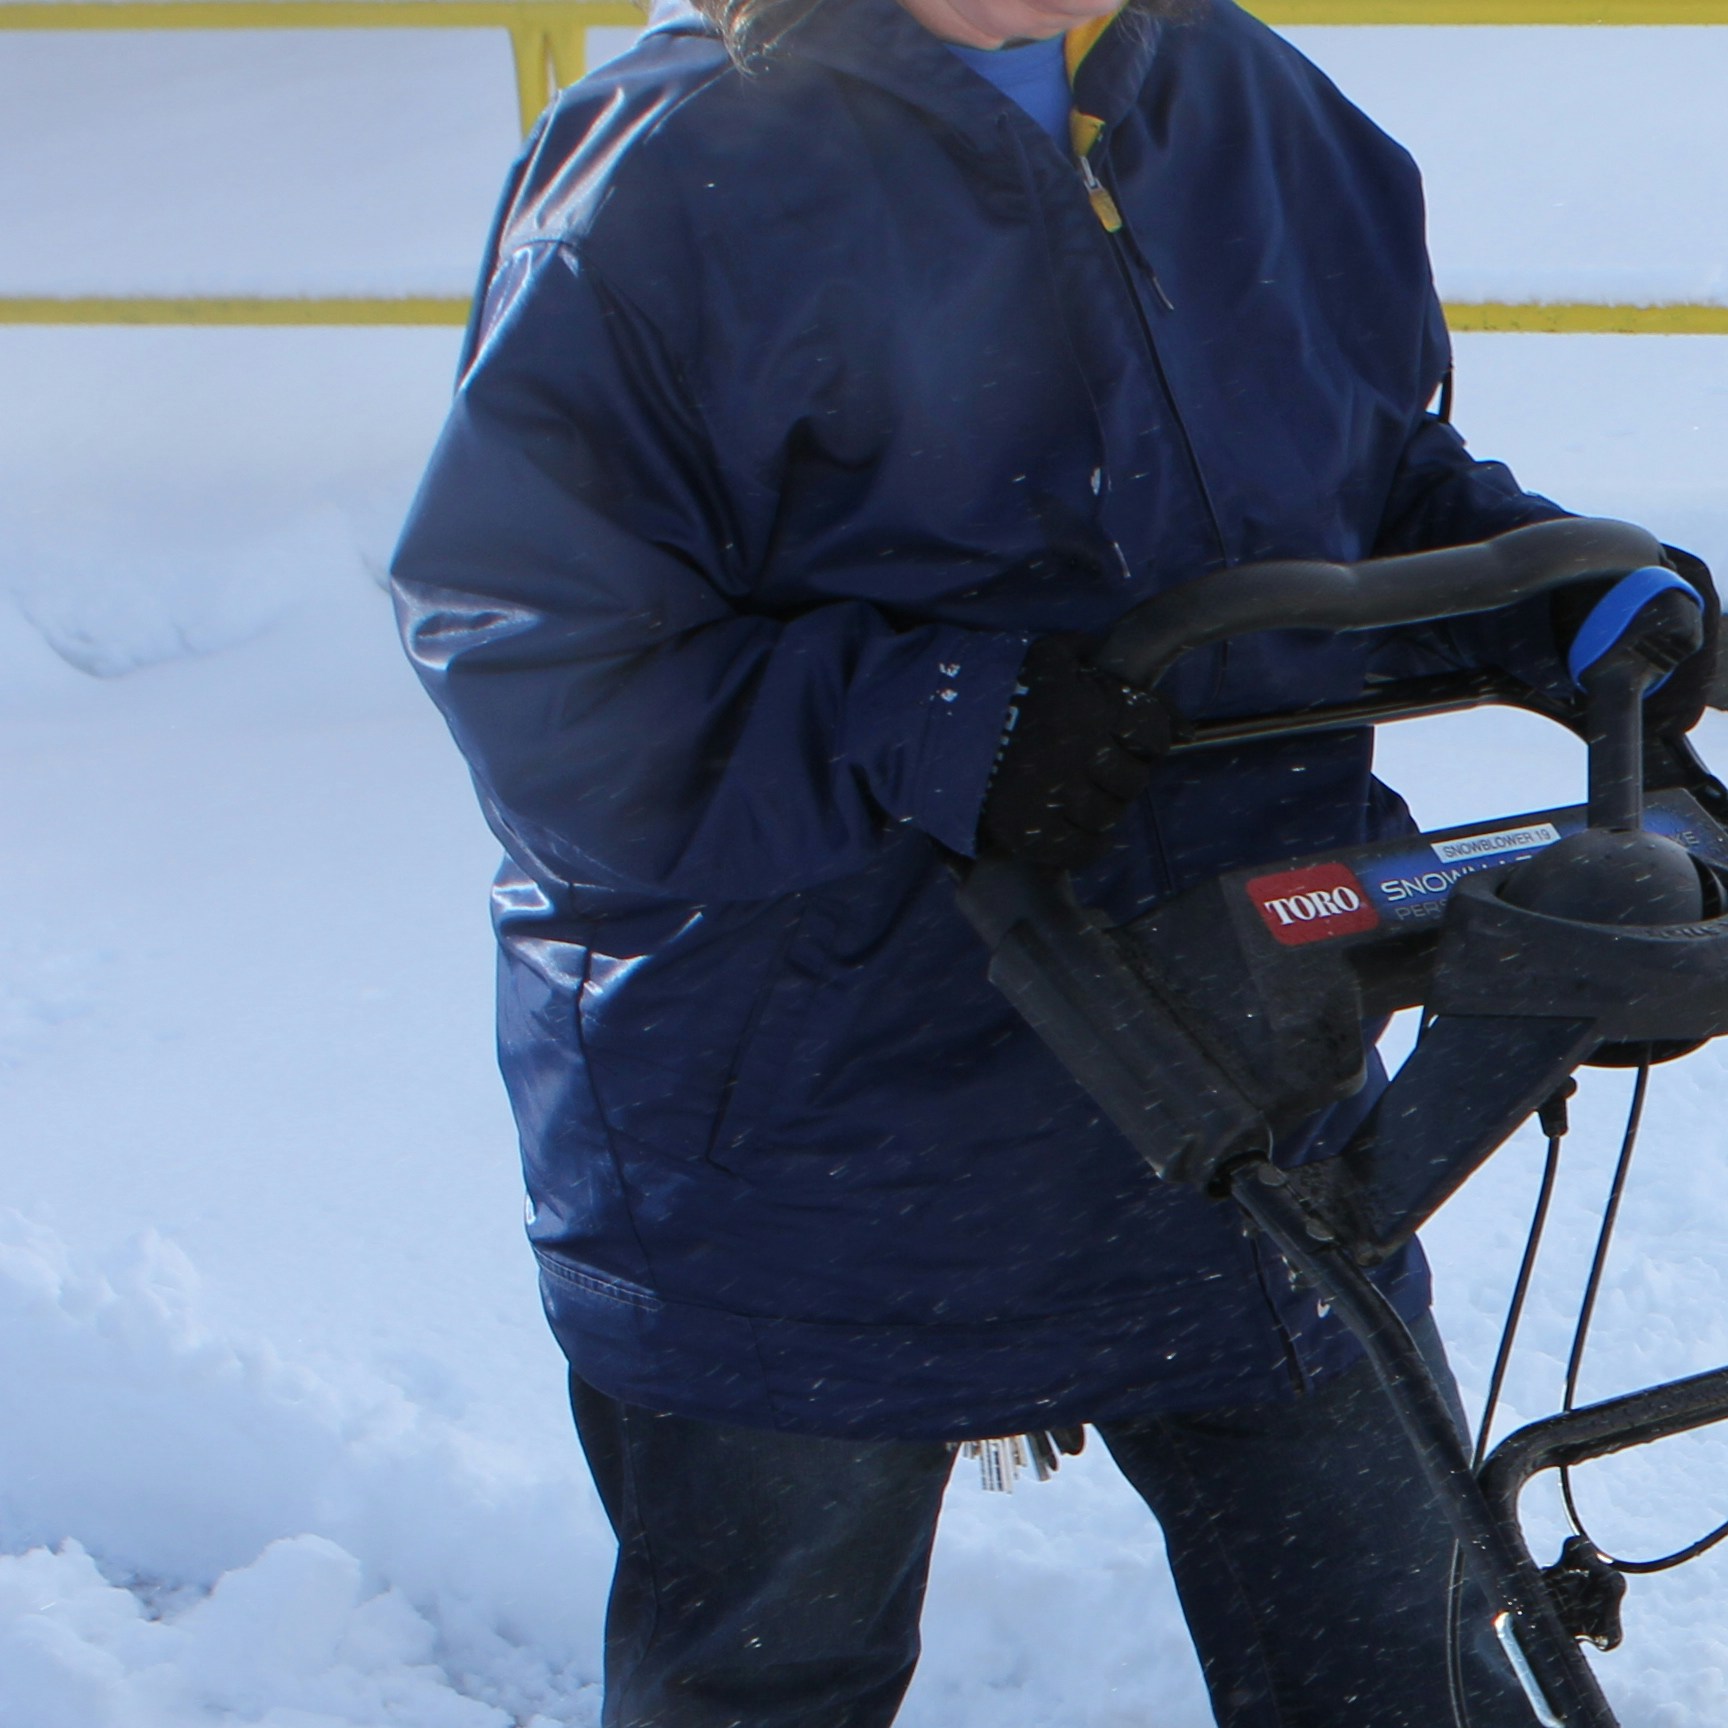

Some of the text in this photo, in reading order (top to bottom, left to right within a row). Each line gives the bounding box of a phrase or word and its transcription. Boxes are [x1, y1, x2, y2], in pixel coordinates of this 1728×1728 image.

[1443, 827, 1552, 860] SNOWBLOWER 19
[1264, 885, 1361, 926] TORO
